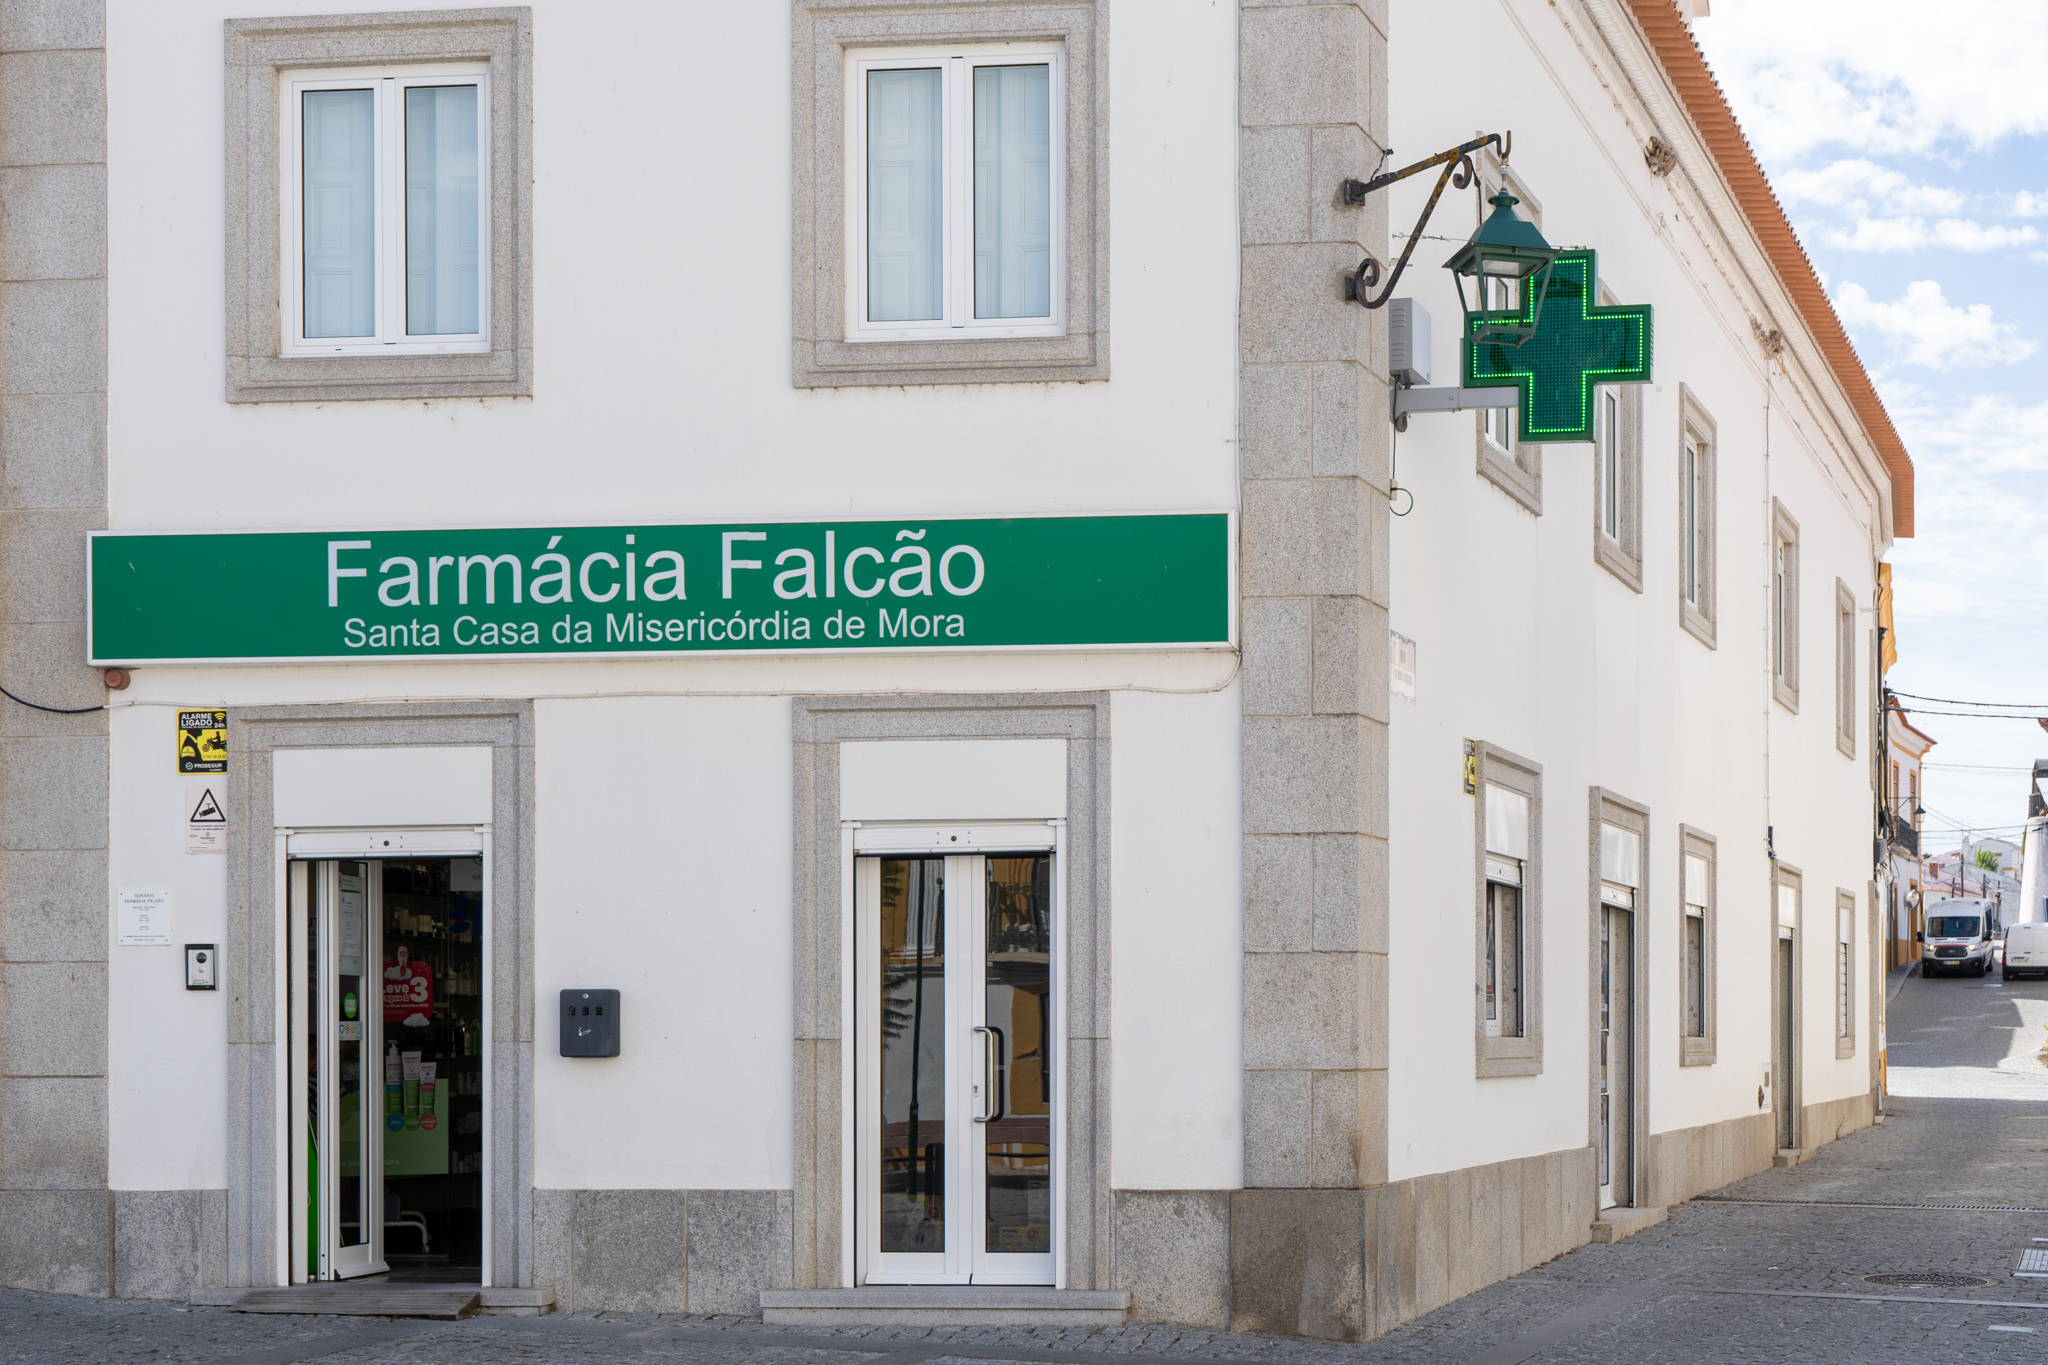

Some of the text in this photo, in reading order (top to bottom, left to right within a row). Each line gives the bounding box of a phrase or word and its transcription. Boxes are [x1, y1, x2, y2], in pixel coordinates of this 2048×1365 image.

[327, 527, 985, 608] Farmácia Falcão
[344, 607, 966, 648] Santa Casa da Misericórdia de Mora
[383, 976, 428, 1002] eve 3
[403, 994, 410, 1002] 2
